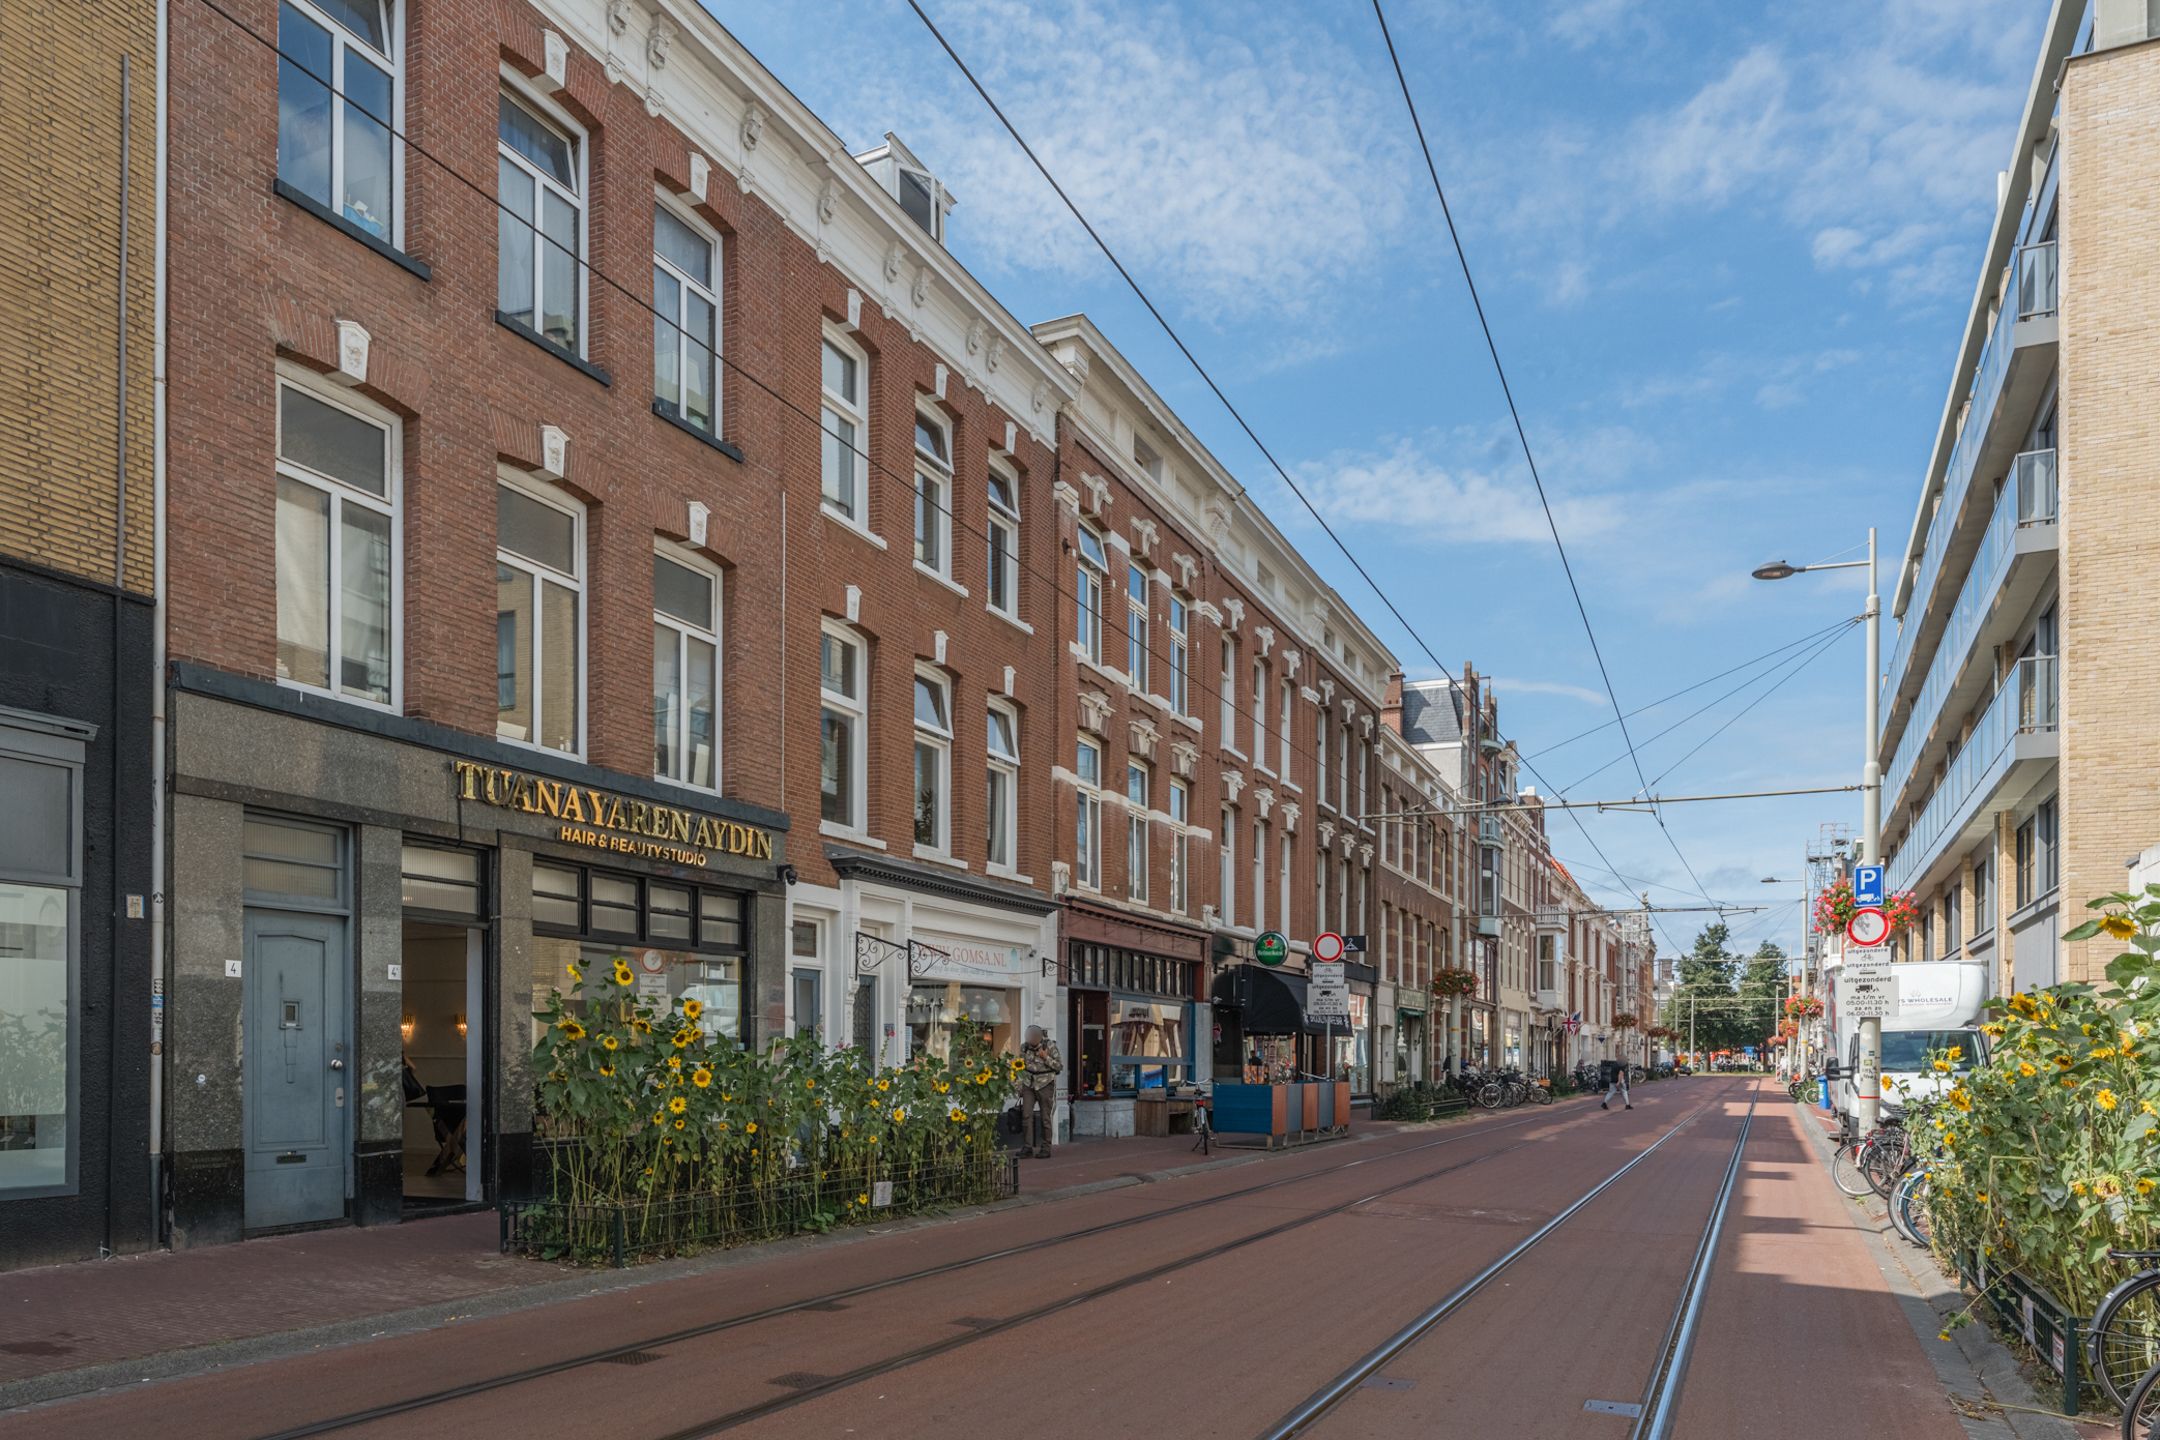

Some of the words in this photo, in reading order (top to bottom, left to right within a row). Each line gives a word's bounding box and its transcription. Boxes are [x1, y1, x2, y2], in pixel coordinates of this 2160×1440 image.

[455, 760, 586, 823] TUANA
[588, 790, 691, 844] YAREN
[694, 815, 773, 861] AYDIN
[561, 826, 596, 847] HAIR
[598, 833, 608, 849] &
[1860, 869, 1877, 891] P
[230, 962, 237, 975] 4
[1843, 976, 1892, 985] uitgezonderd
